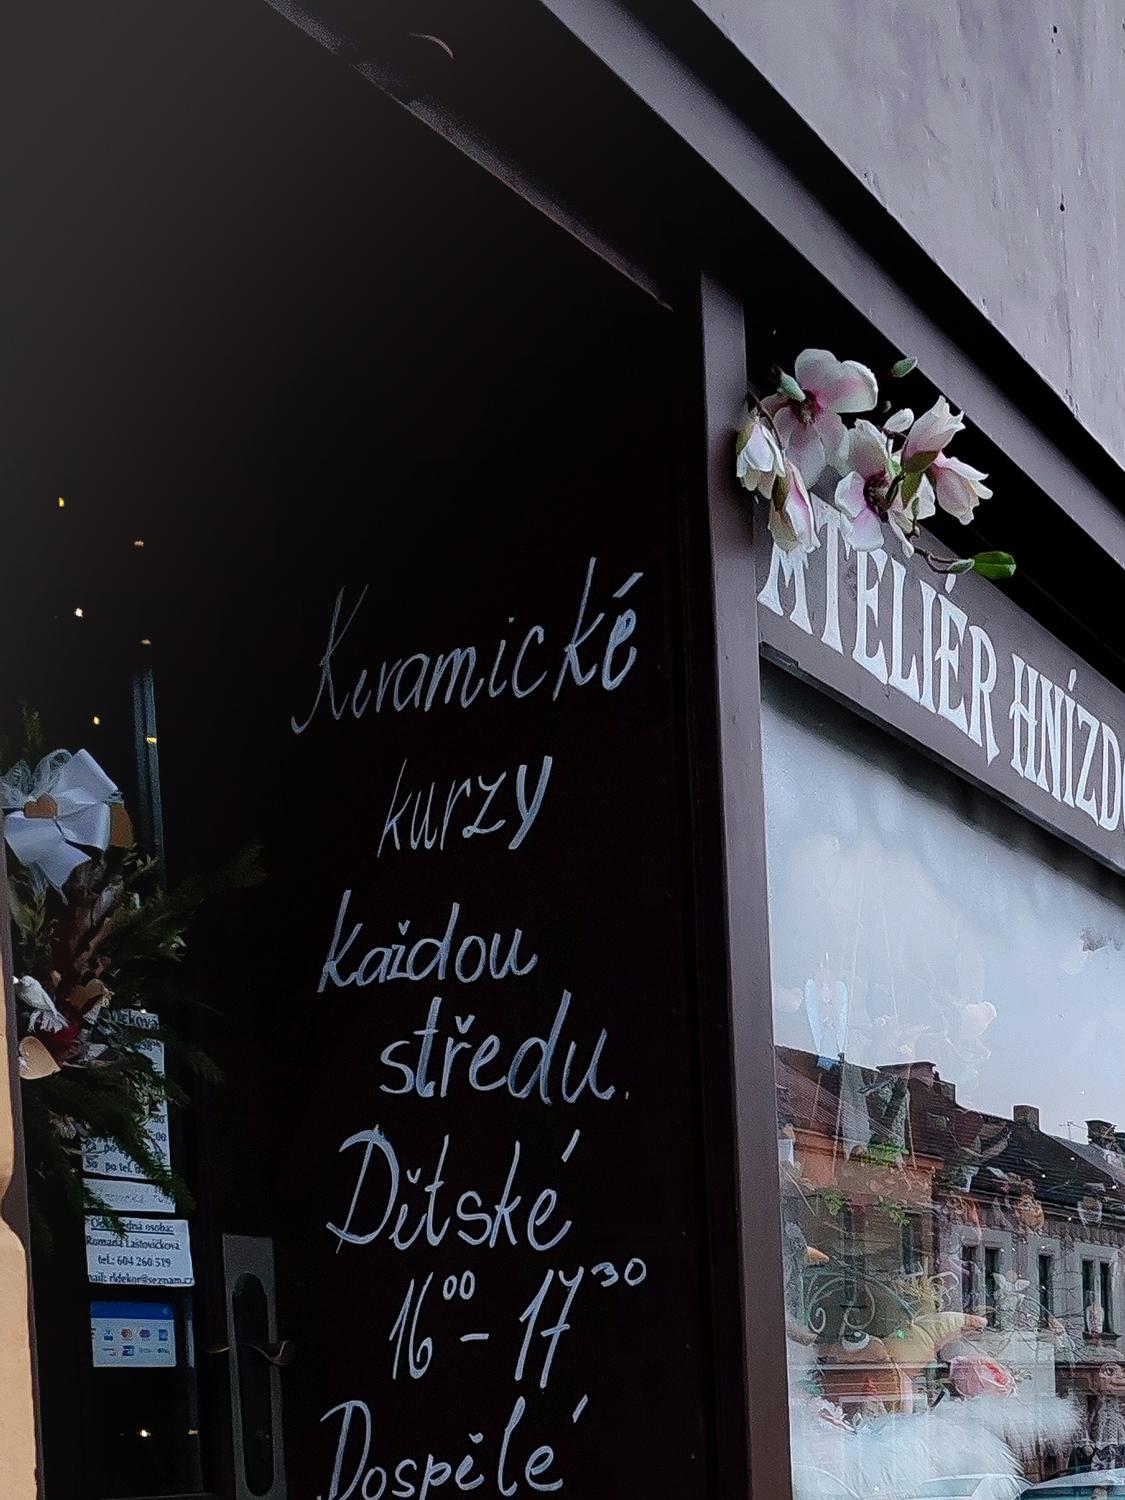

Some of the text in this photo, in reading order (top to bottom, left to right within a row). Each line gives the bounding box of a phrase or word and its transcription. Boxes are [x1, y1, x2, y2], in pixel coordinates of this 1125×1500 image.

[290, 556, 644, 735] Keramické
[377, 755, 553, 858] kurzy
[326, 1124, 581, 1254] Dětské
[116, 1255, 134, 1266] 604
[135, 1256, 153, 1267] 260
[154, 1257, 172, 1268] 519
